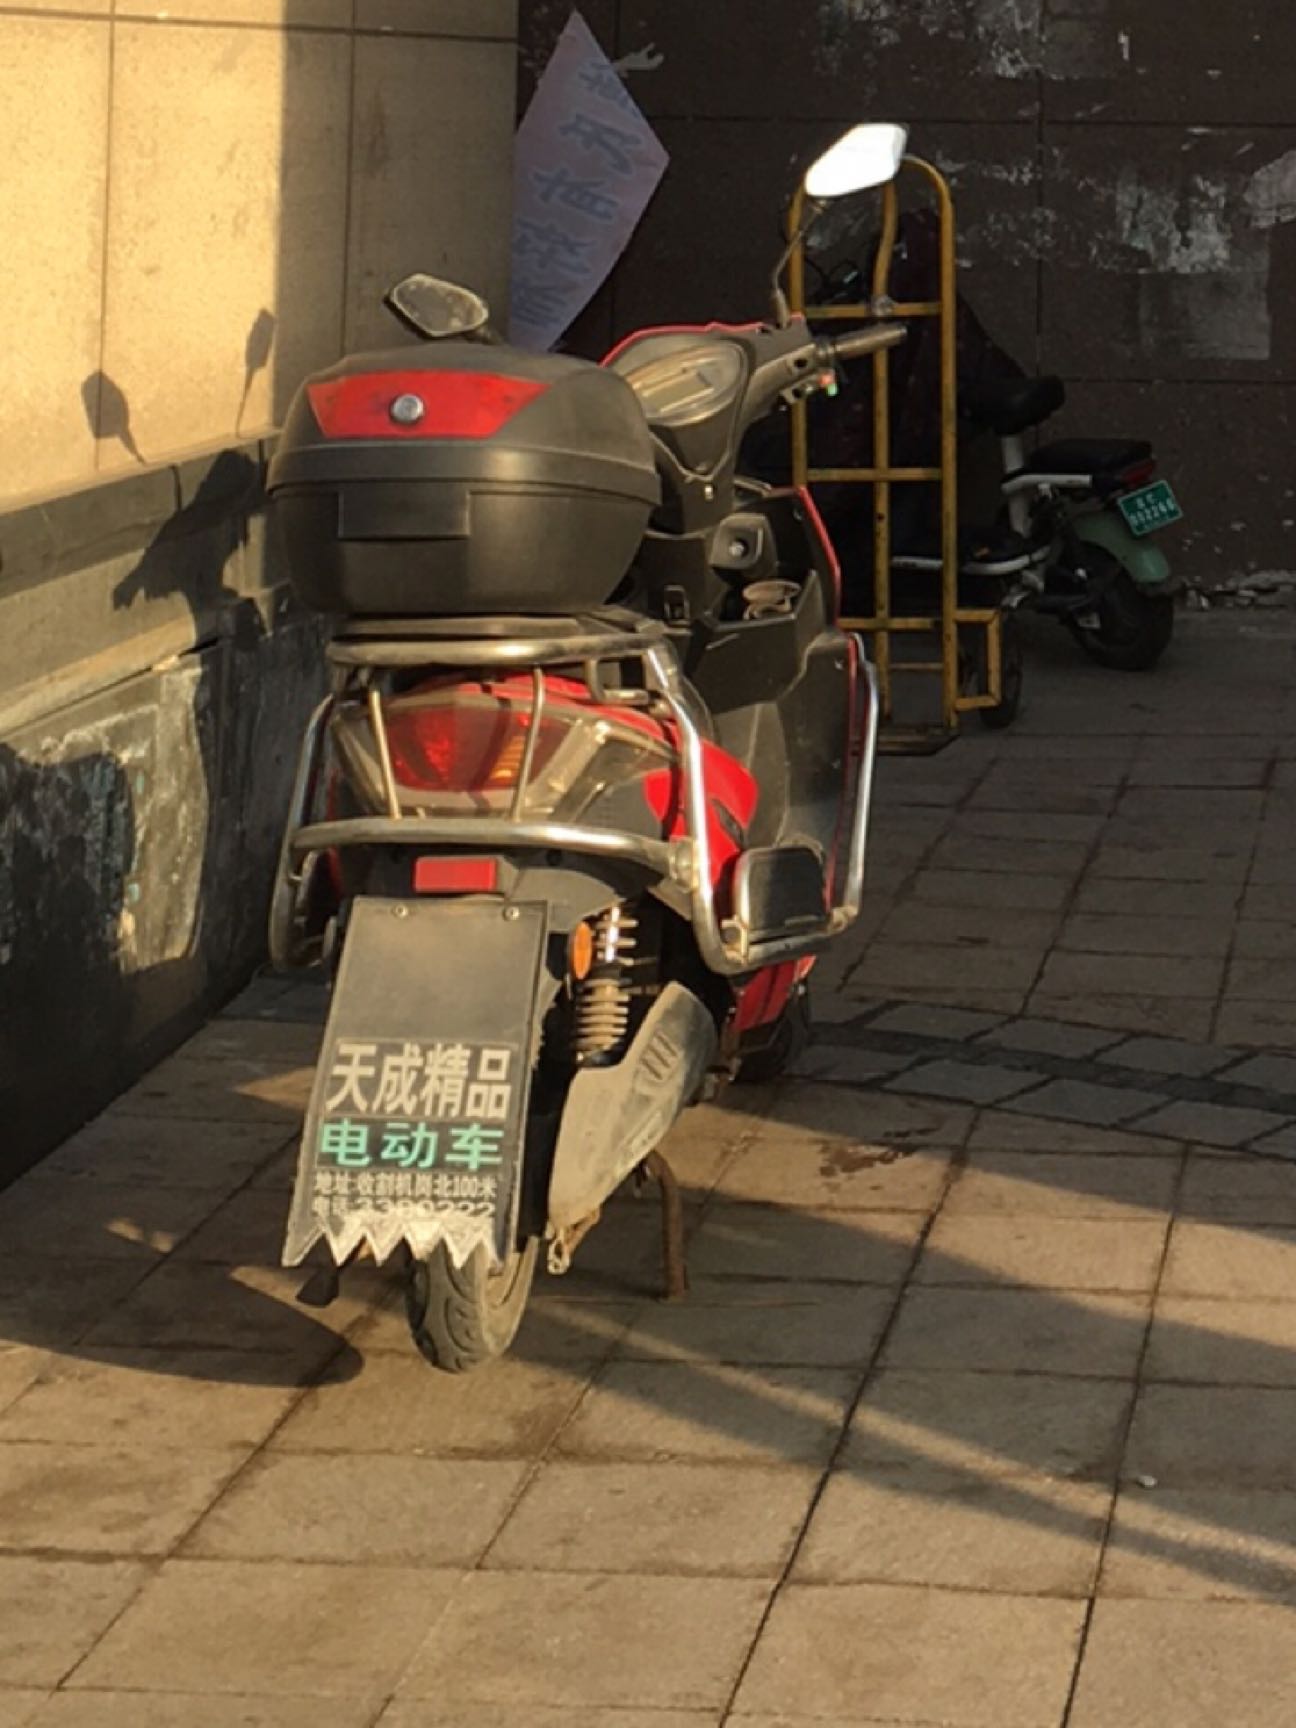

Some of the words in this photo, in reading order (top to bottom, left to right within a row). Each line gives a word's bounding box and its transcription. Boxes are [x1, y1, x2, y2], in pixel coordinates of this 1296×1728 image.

[325, 1042, 511, 1119] 天成精品
[320, 1118, 504, 1171] 电动车
